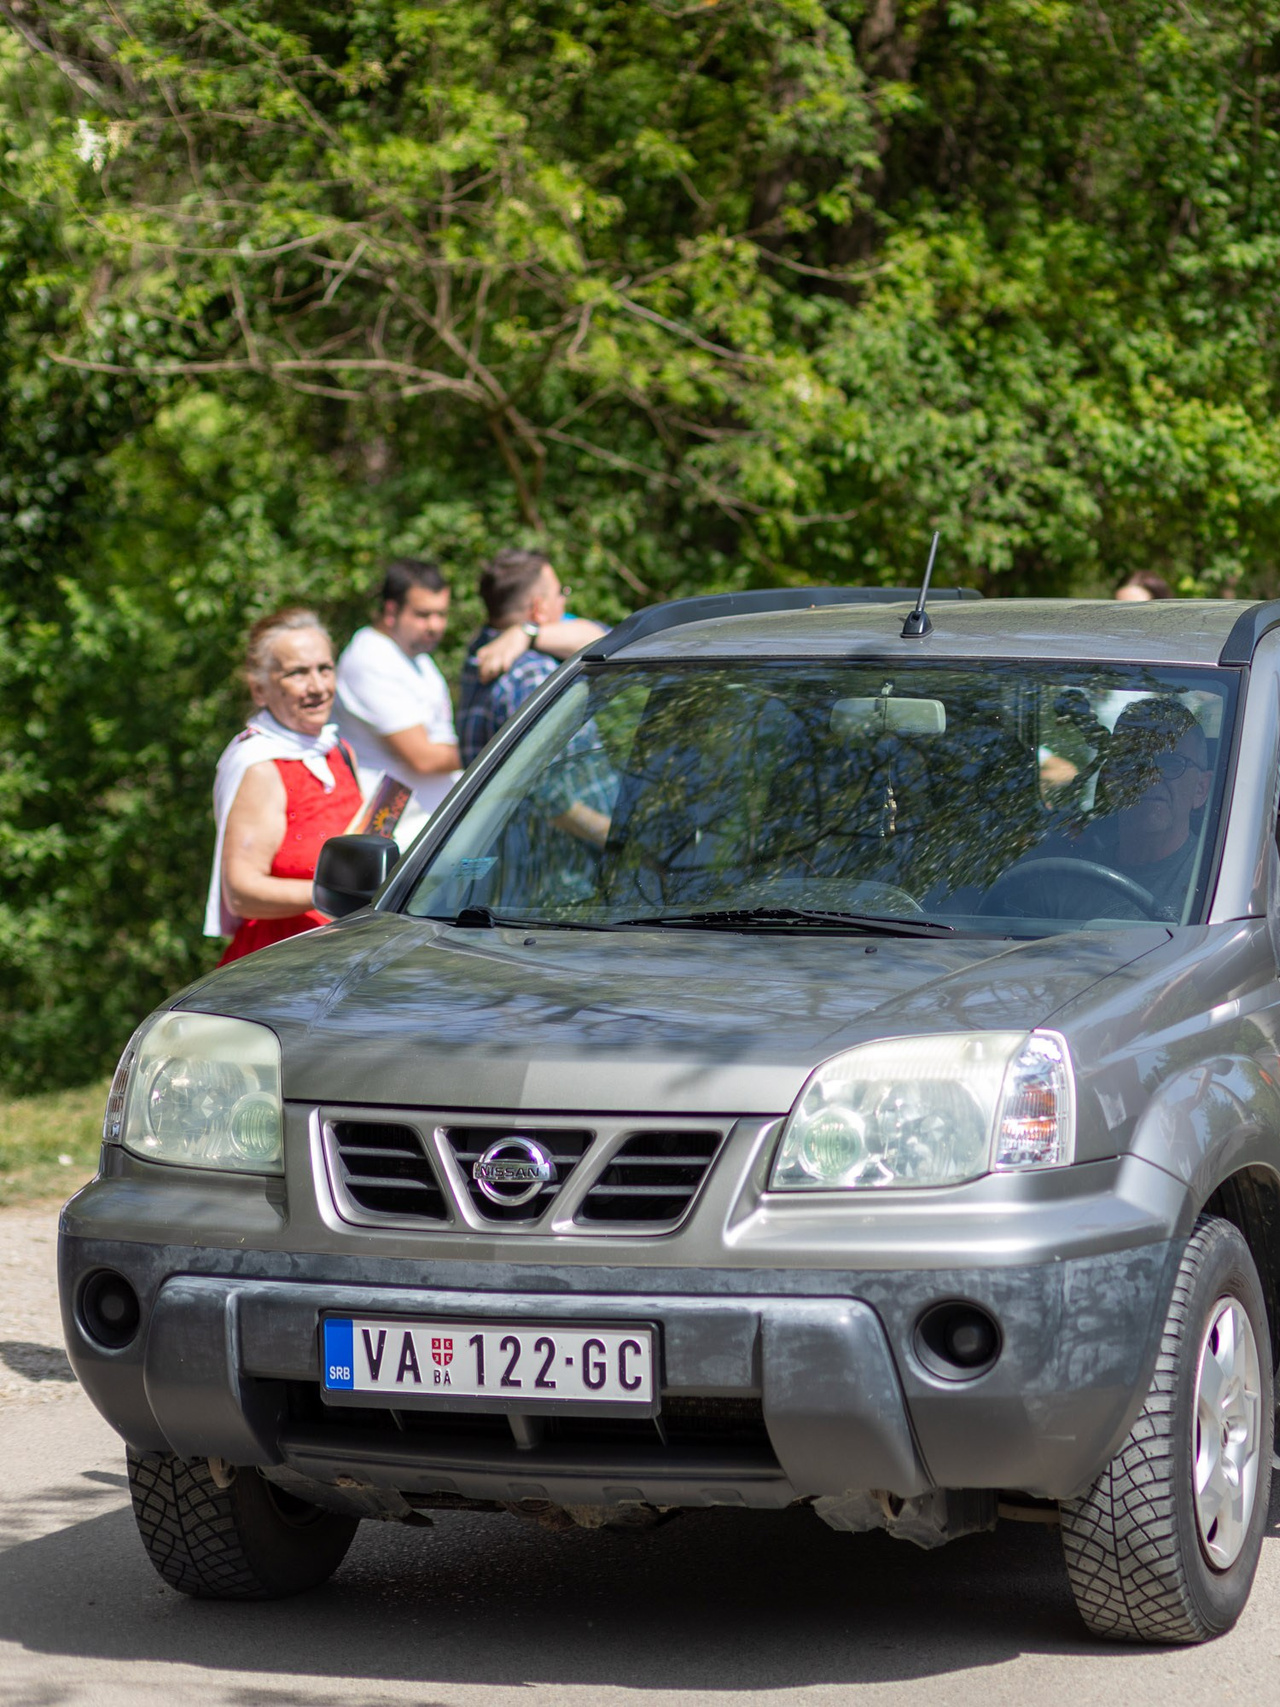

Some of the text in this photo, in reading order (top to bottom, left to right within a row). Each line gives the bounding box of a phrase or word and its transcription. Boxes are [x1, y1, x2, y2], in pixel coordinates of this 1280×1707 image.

[481, 1166, 541, 1178] NISSAN
[361, 1328, 423, 1384] VA
[329, 1366, 351, 1380] SRB
